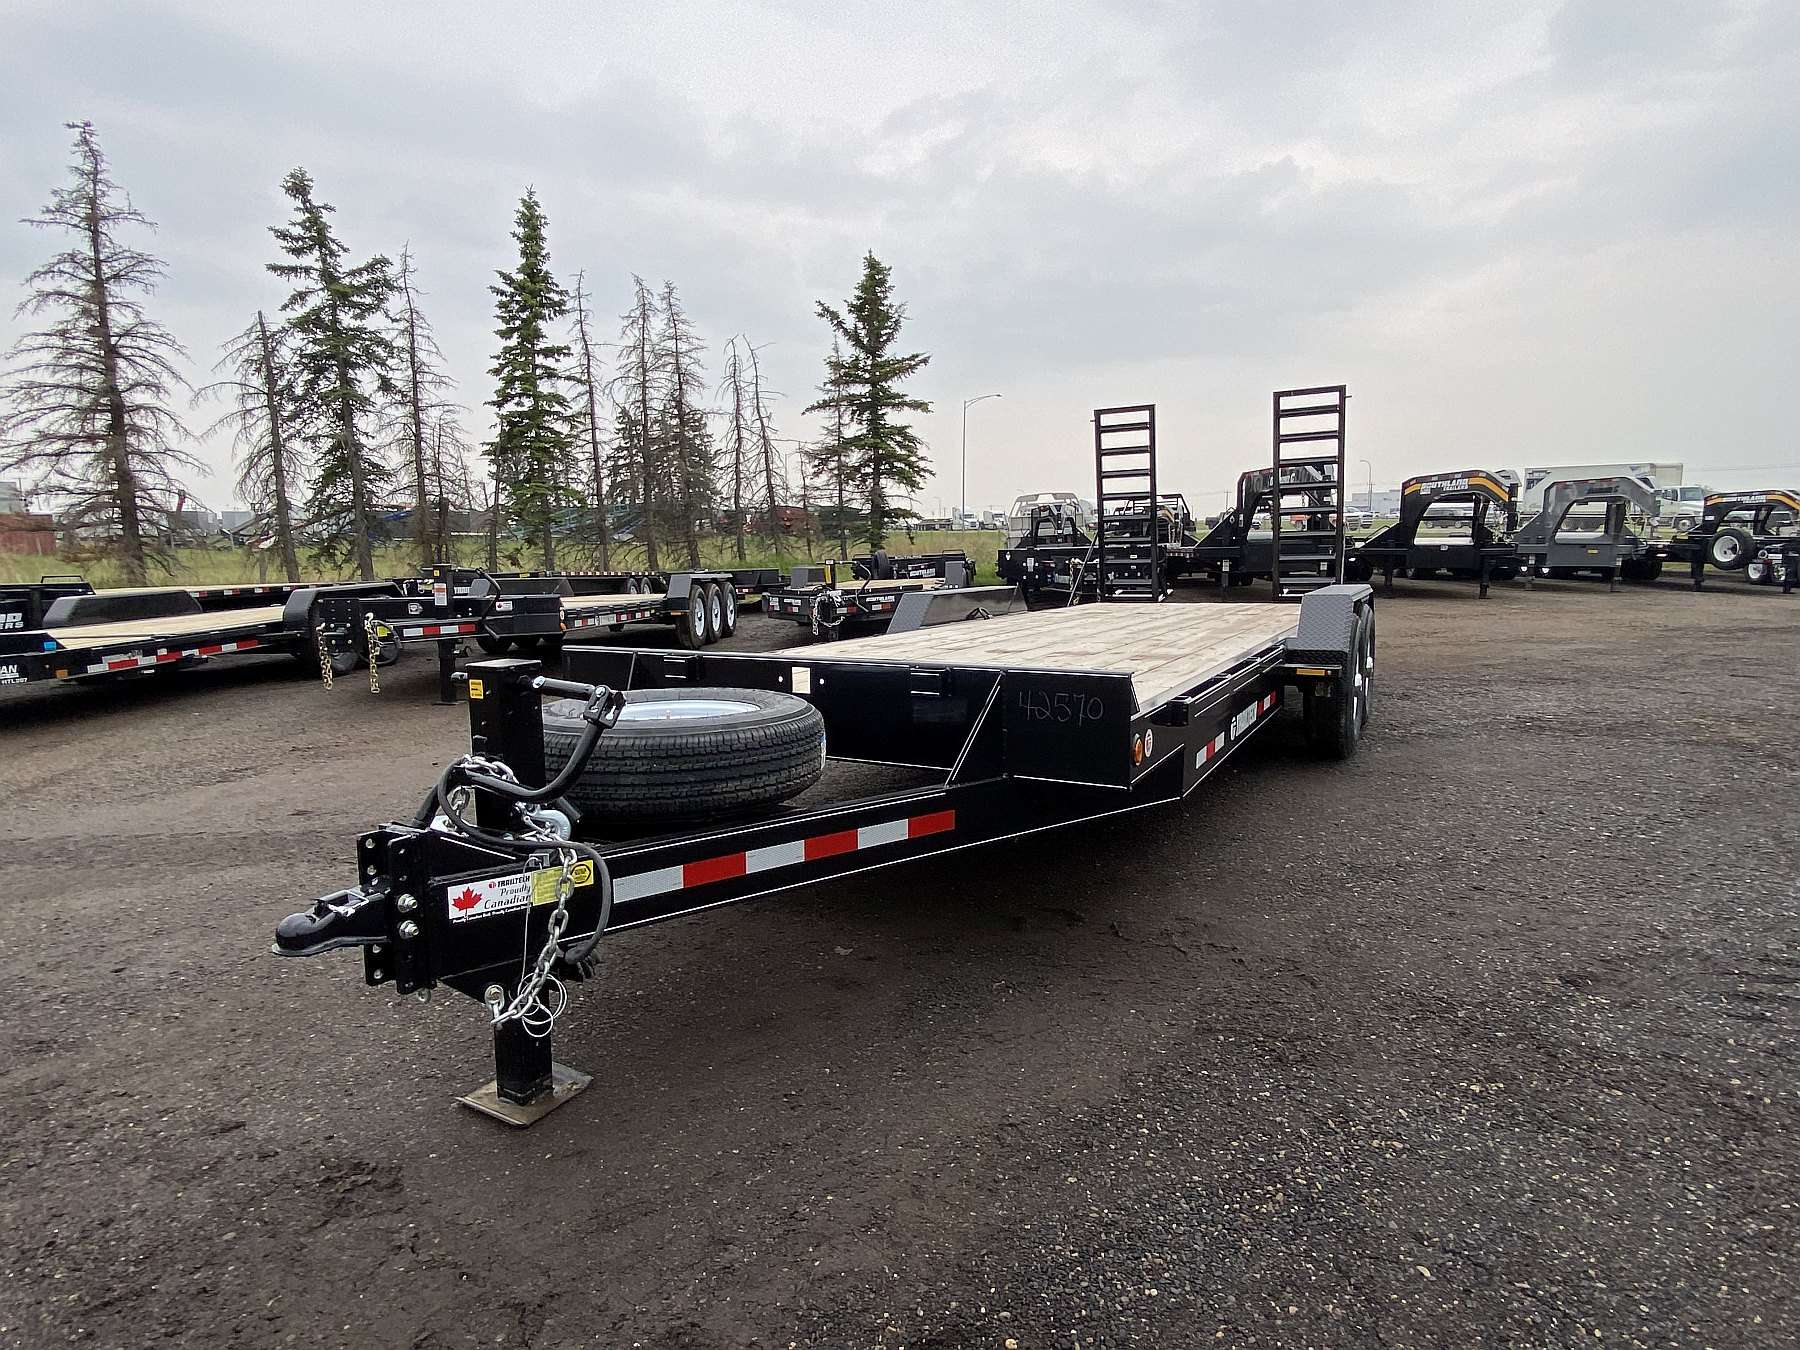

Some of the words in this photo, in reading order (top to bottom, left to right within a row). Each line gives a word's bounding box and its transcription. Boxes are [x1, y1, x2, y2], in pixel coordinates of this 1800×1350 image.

[1019, 690, 1104, 727] 42570
[497, 875, 530, 888] TRAILTECH
[500, 883, 531, 897] Proudly
[484, 894, 531, 910] Canadian
